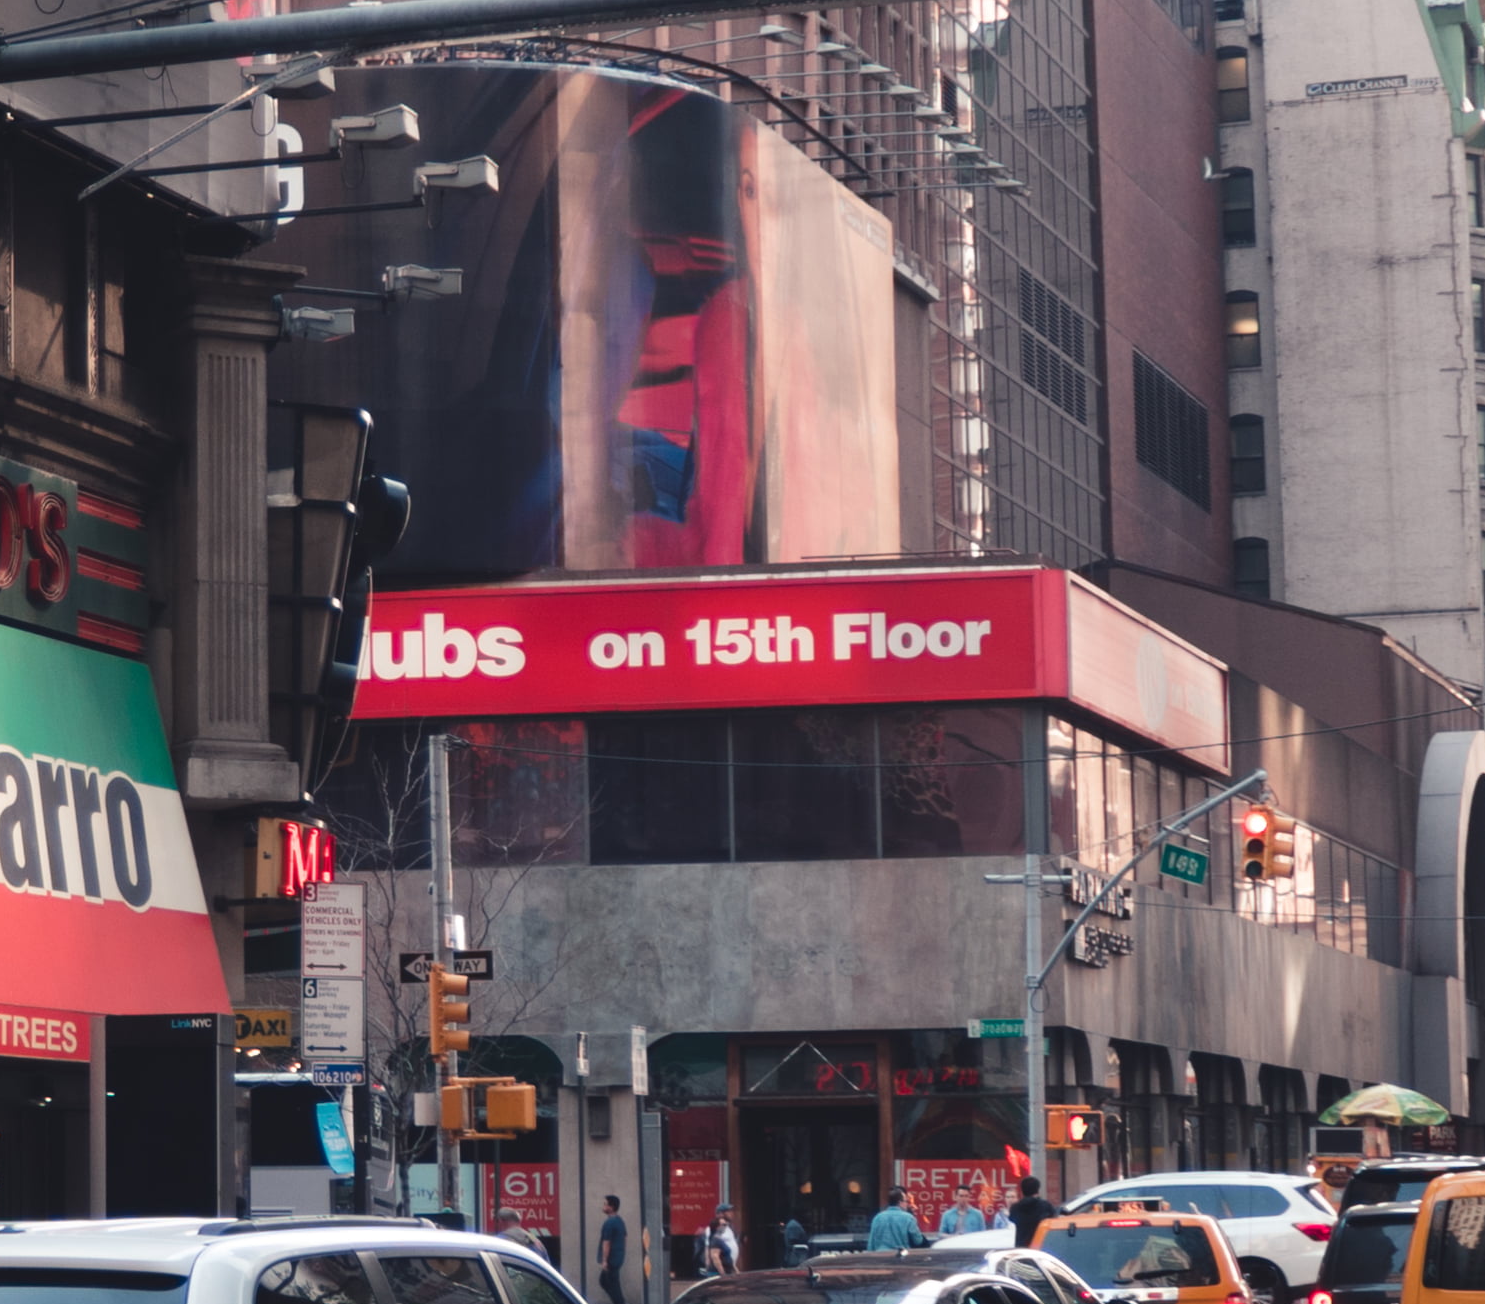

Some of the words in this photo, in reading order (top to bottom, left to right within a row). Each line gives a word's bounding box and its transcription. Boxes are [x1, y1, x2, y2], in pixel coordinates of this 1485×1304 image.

[588, 628, 665, 670] on
[684, 616, 815, 667] 15th
[832, 610, 992, 662] Floor
[305, 883, 316, 901] 3
[305, 905, 354, 916] COMMERCIAL
[305, 916, 341, 925] VEHICLES
[342, 917, 362, 926] ONLY
[413, 955, 434, 974] ON
[304, 979, 316, 997] 6
[171, 1018, 212, 1028] LinkNYC
[906, 1168, 1018, 1188] RETAIL
